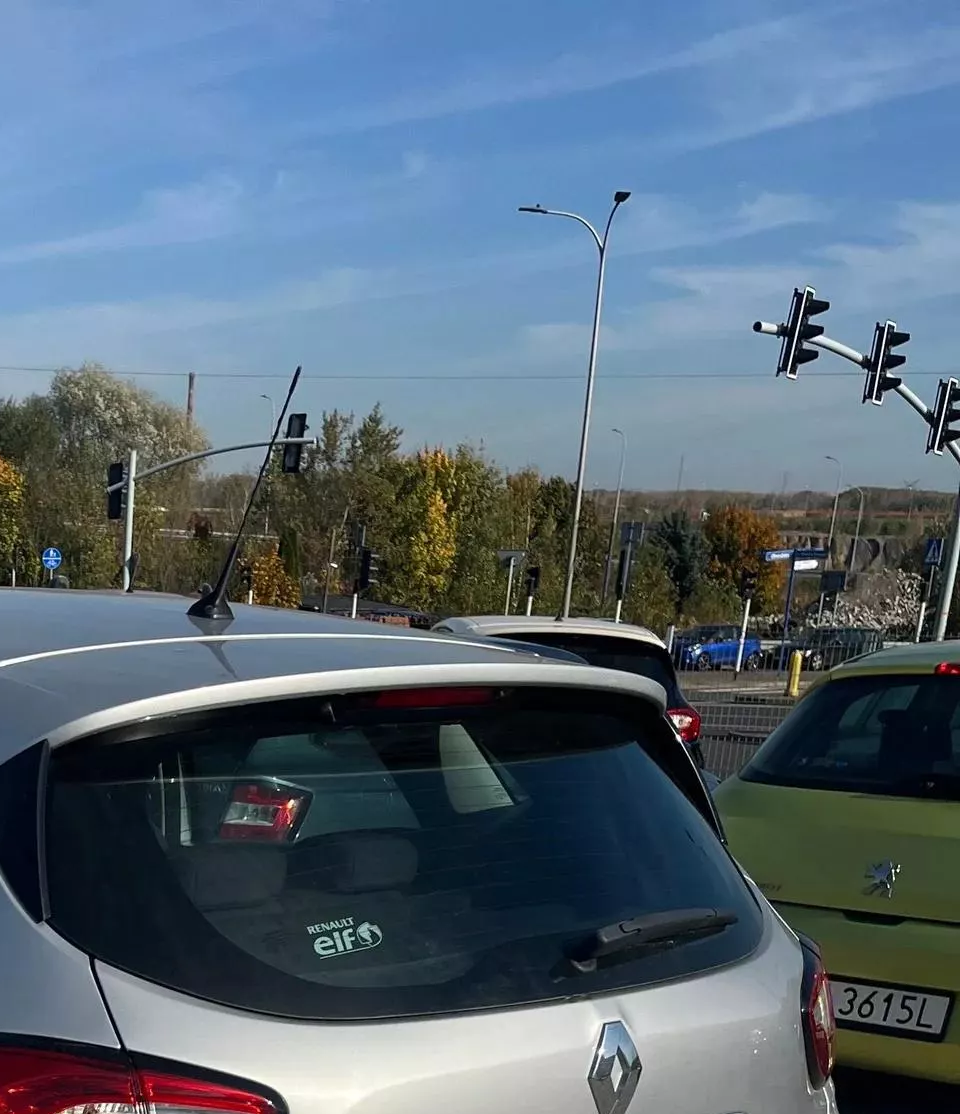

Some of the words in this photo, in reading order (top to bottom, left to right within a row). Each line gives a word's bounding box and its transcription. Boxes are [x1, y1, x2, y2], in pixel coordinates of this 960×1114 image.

[307, 916, 354, 935] RENAULT
[314, 928, 356, 955] elf
[838, 987, 933, 1029] 3615L
